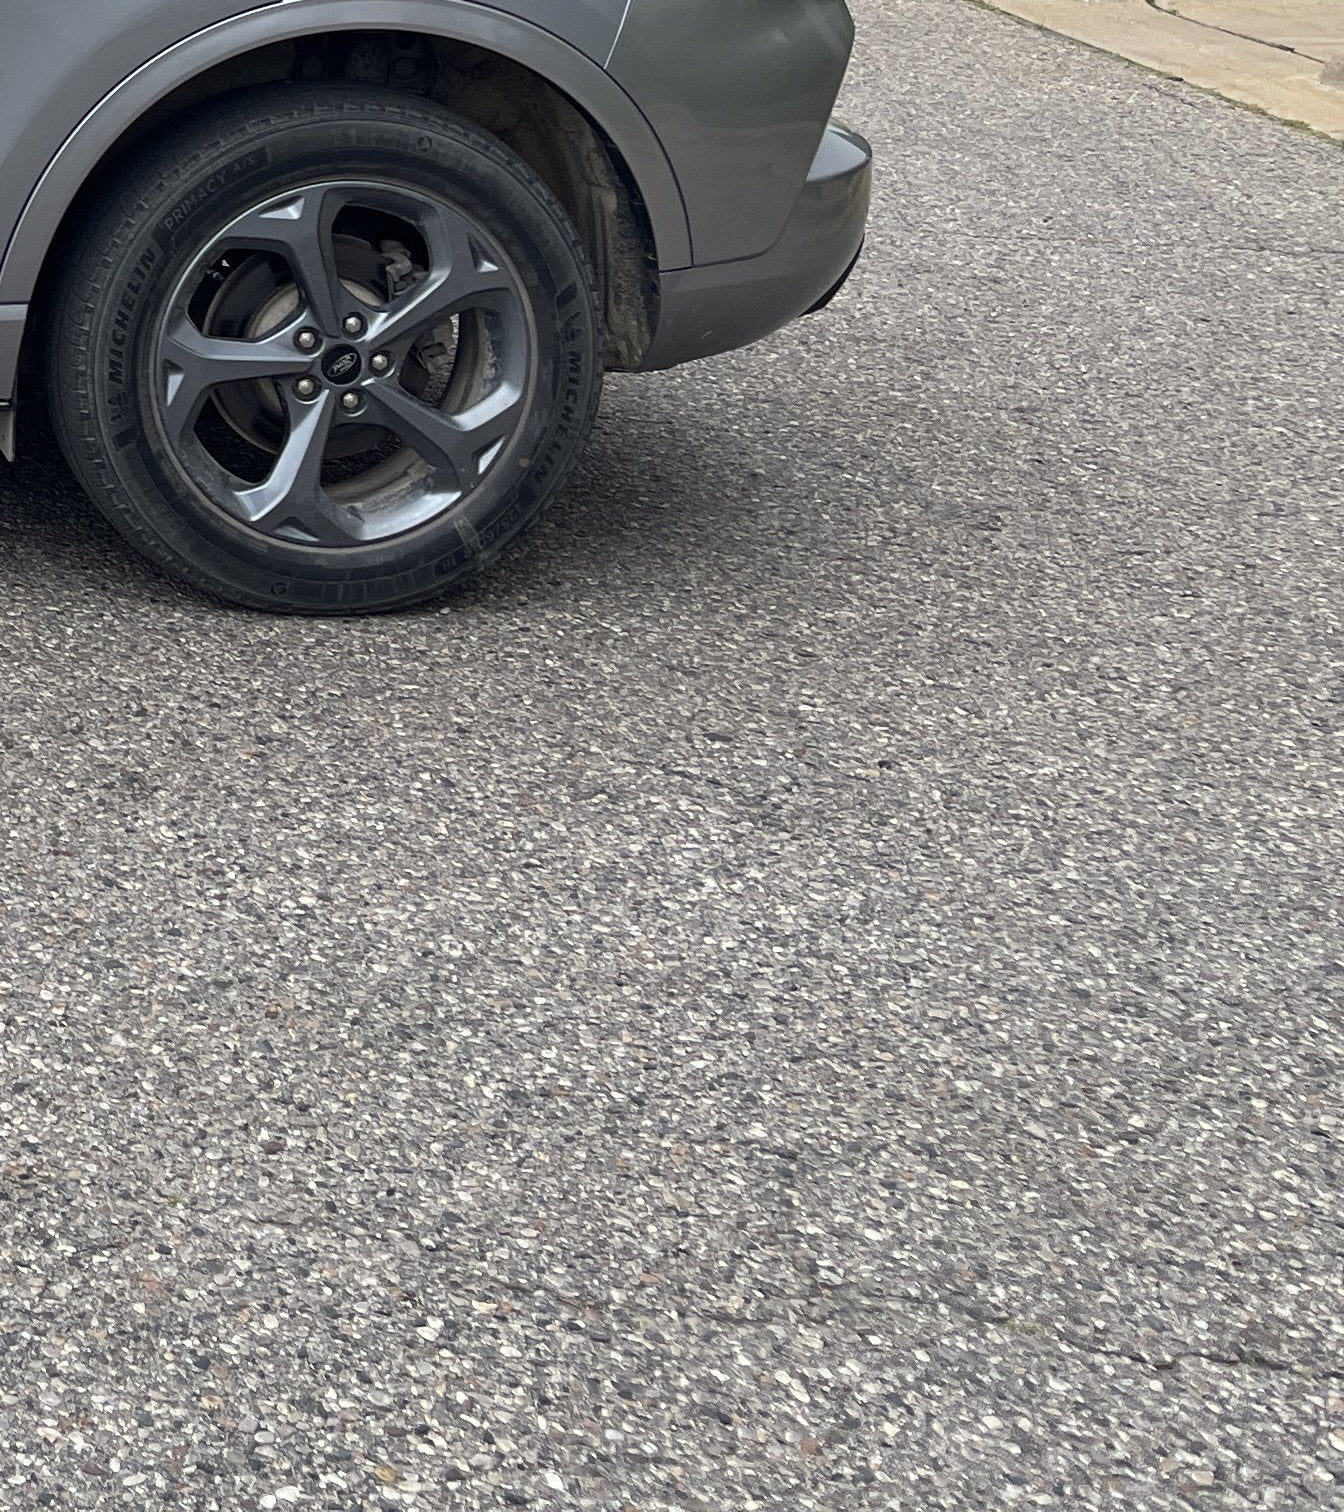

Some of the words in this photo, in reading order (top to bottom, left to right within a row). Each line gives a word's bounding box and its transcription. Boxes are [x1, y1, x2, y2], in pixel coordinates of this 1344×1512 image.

[108, 247, 158, 385] MICHELIN
[164, 171, 226, 231] PRIMACY
[534, 350, 583, 484] MICHELIN
